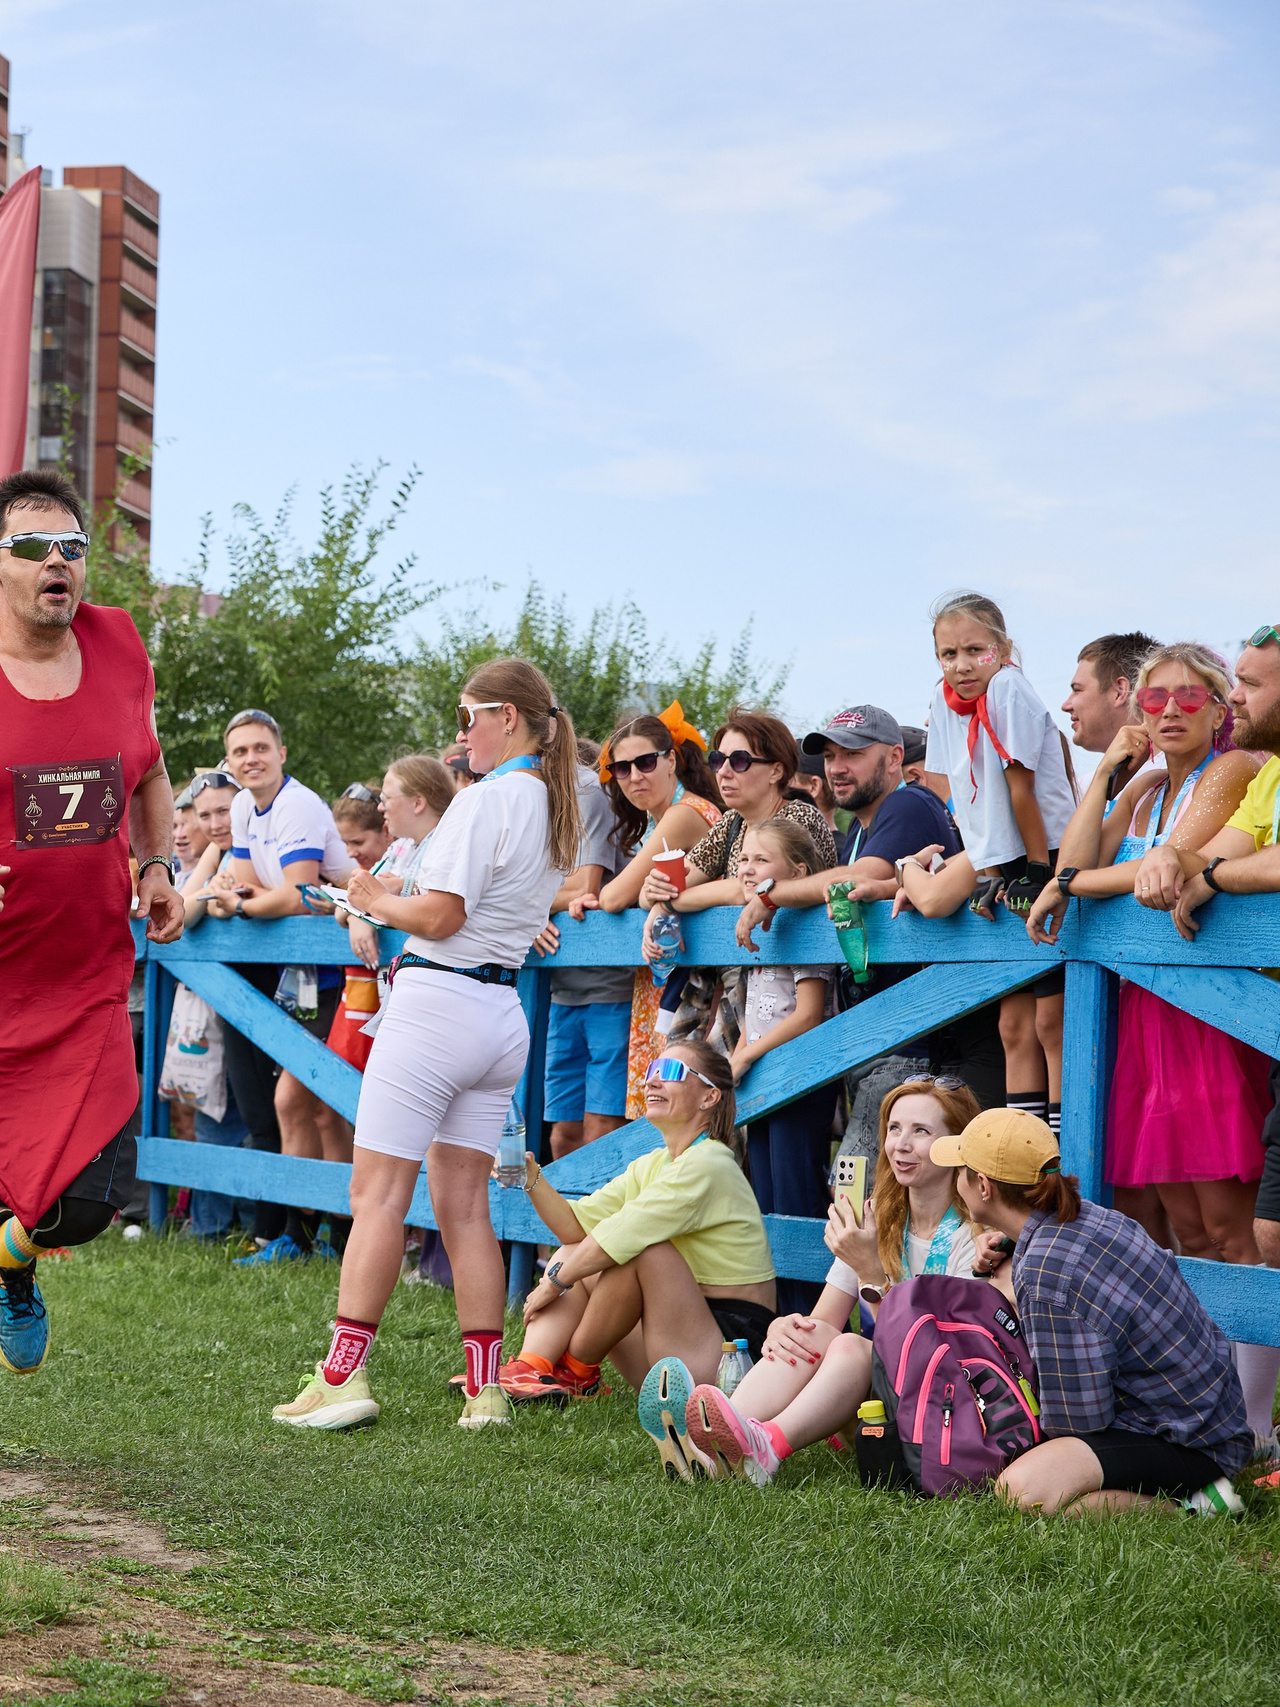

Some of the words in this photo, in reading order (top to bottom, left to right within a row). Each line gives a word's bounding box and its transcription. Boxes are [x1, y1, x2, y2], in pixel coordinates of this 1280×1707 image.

[38, 771, 82, 784] ХИНКАЛЬНАЯ
[82, 770, 101, 780] МИЛЯ
[59, 784, 84, 820] 7
[330, 1337, 351, 1373] КРОСС
[340, 1339, 364, 1373] РЕТРО
